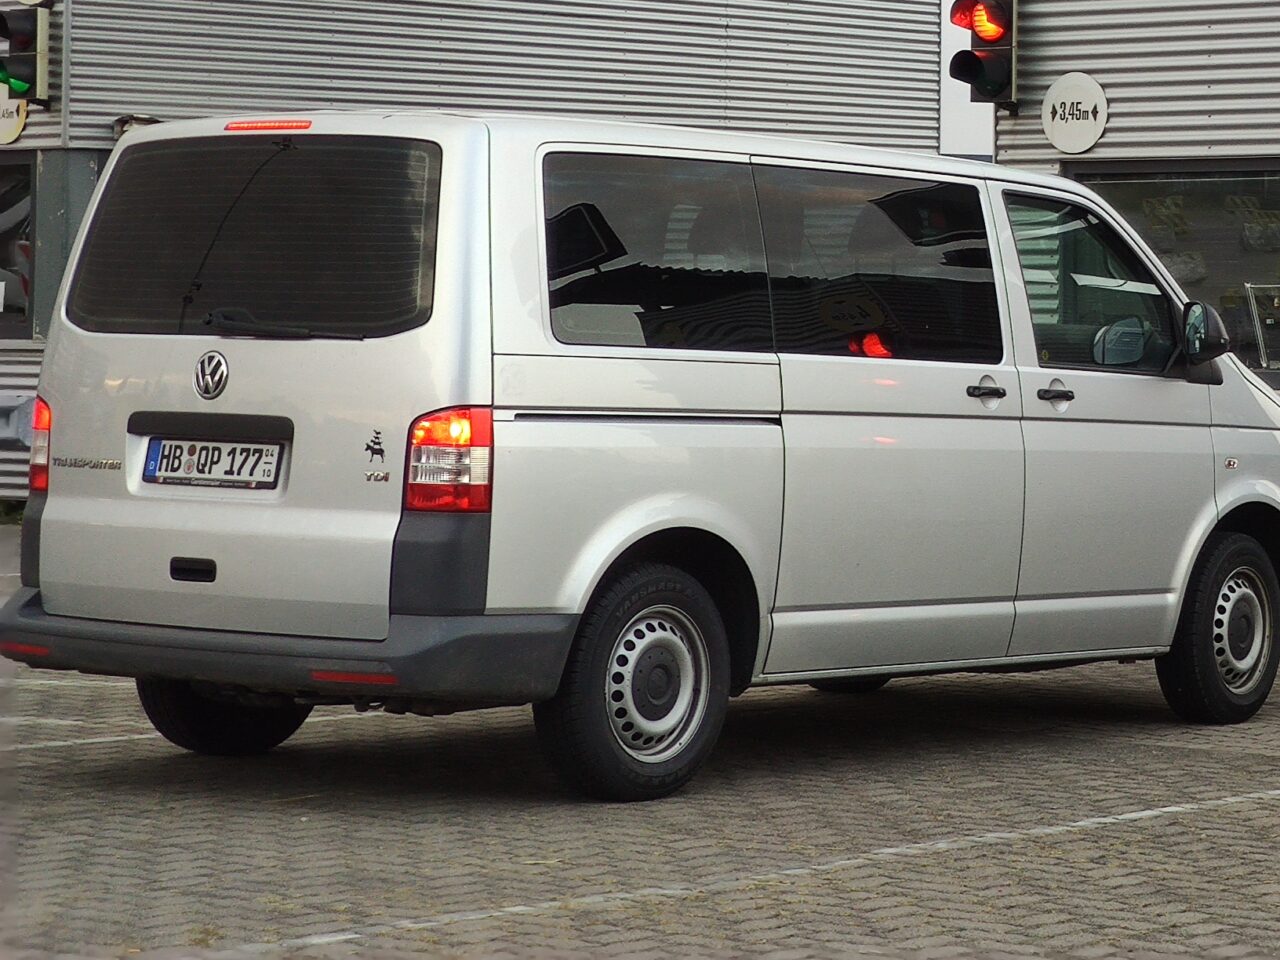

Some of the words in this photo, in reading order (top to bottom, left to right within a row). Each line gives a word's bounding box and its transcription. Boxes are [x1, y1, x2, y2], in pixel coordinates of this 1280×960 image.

[1059, 102, 1089, 124] 3,45m
[158, 444, 184, 473] HB
[196, 446, 222, 475] QP
[224, 447, 264, 477] 177
